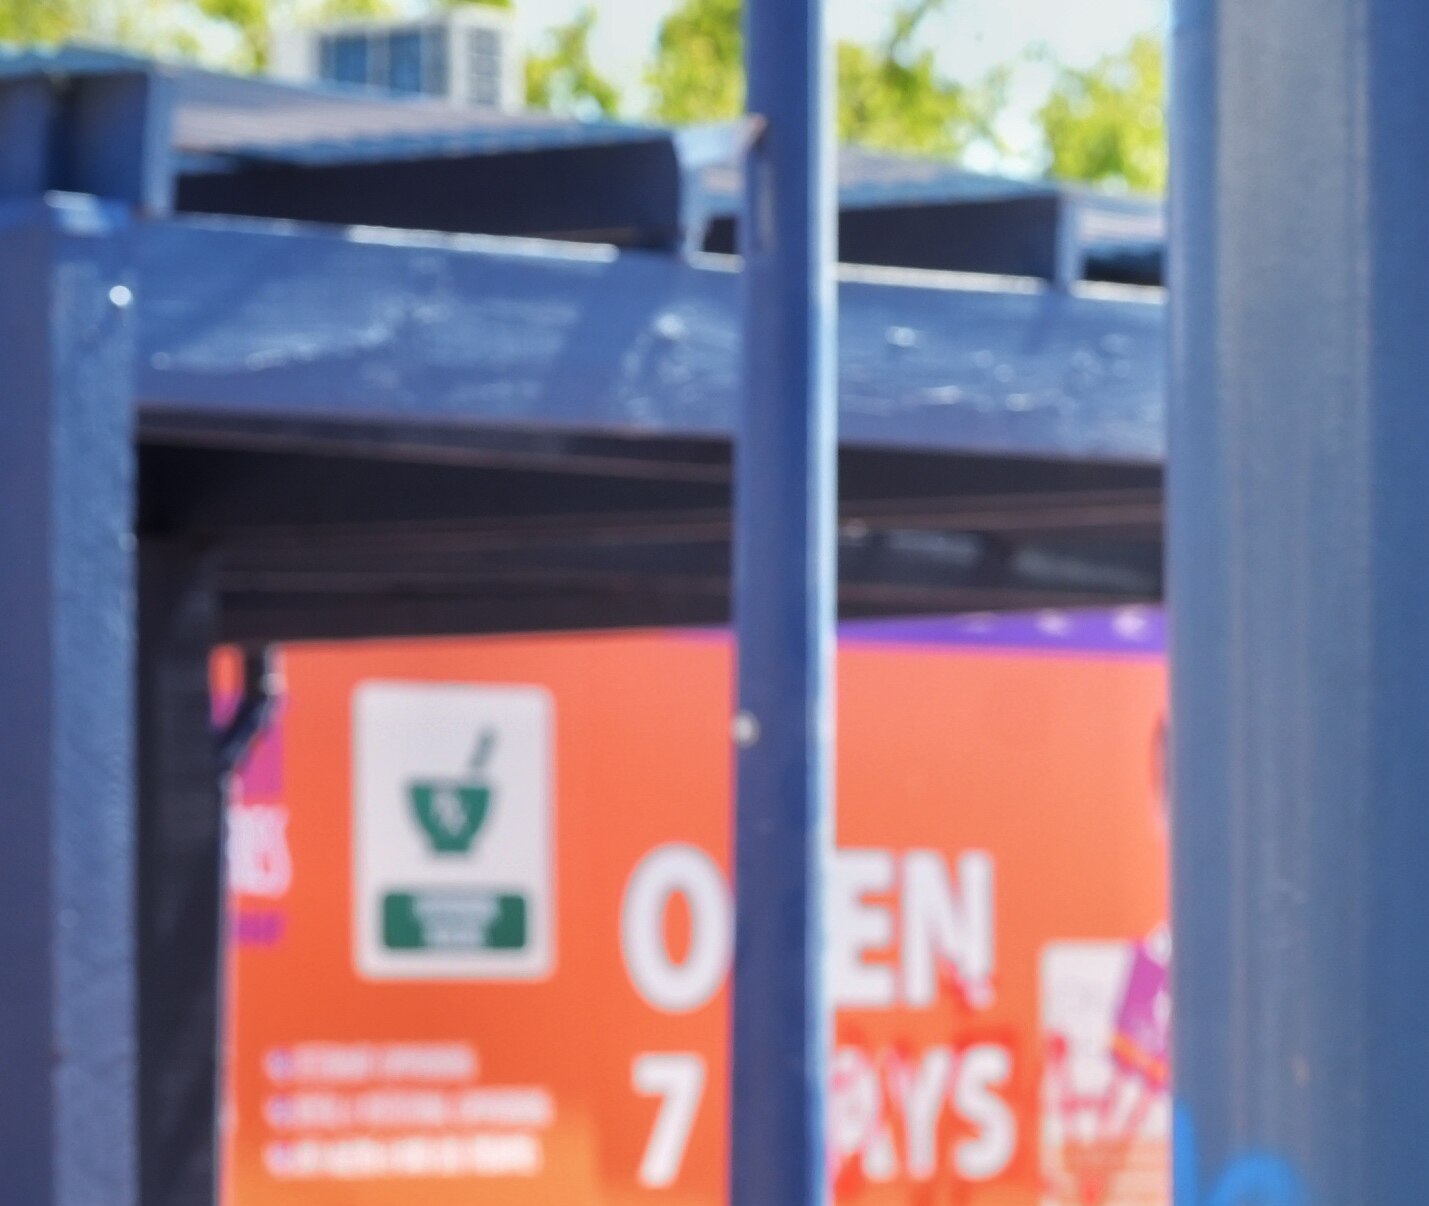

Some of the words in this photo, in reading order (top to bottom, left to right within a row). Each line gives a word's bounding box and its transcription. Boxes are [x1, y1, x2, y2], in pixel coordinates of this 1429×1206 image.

[621, 842, 994, 1013] OEN
[631, 1050, 706, 1188] 7
[829, 1044, 1017, 1180] AYS
